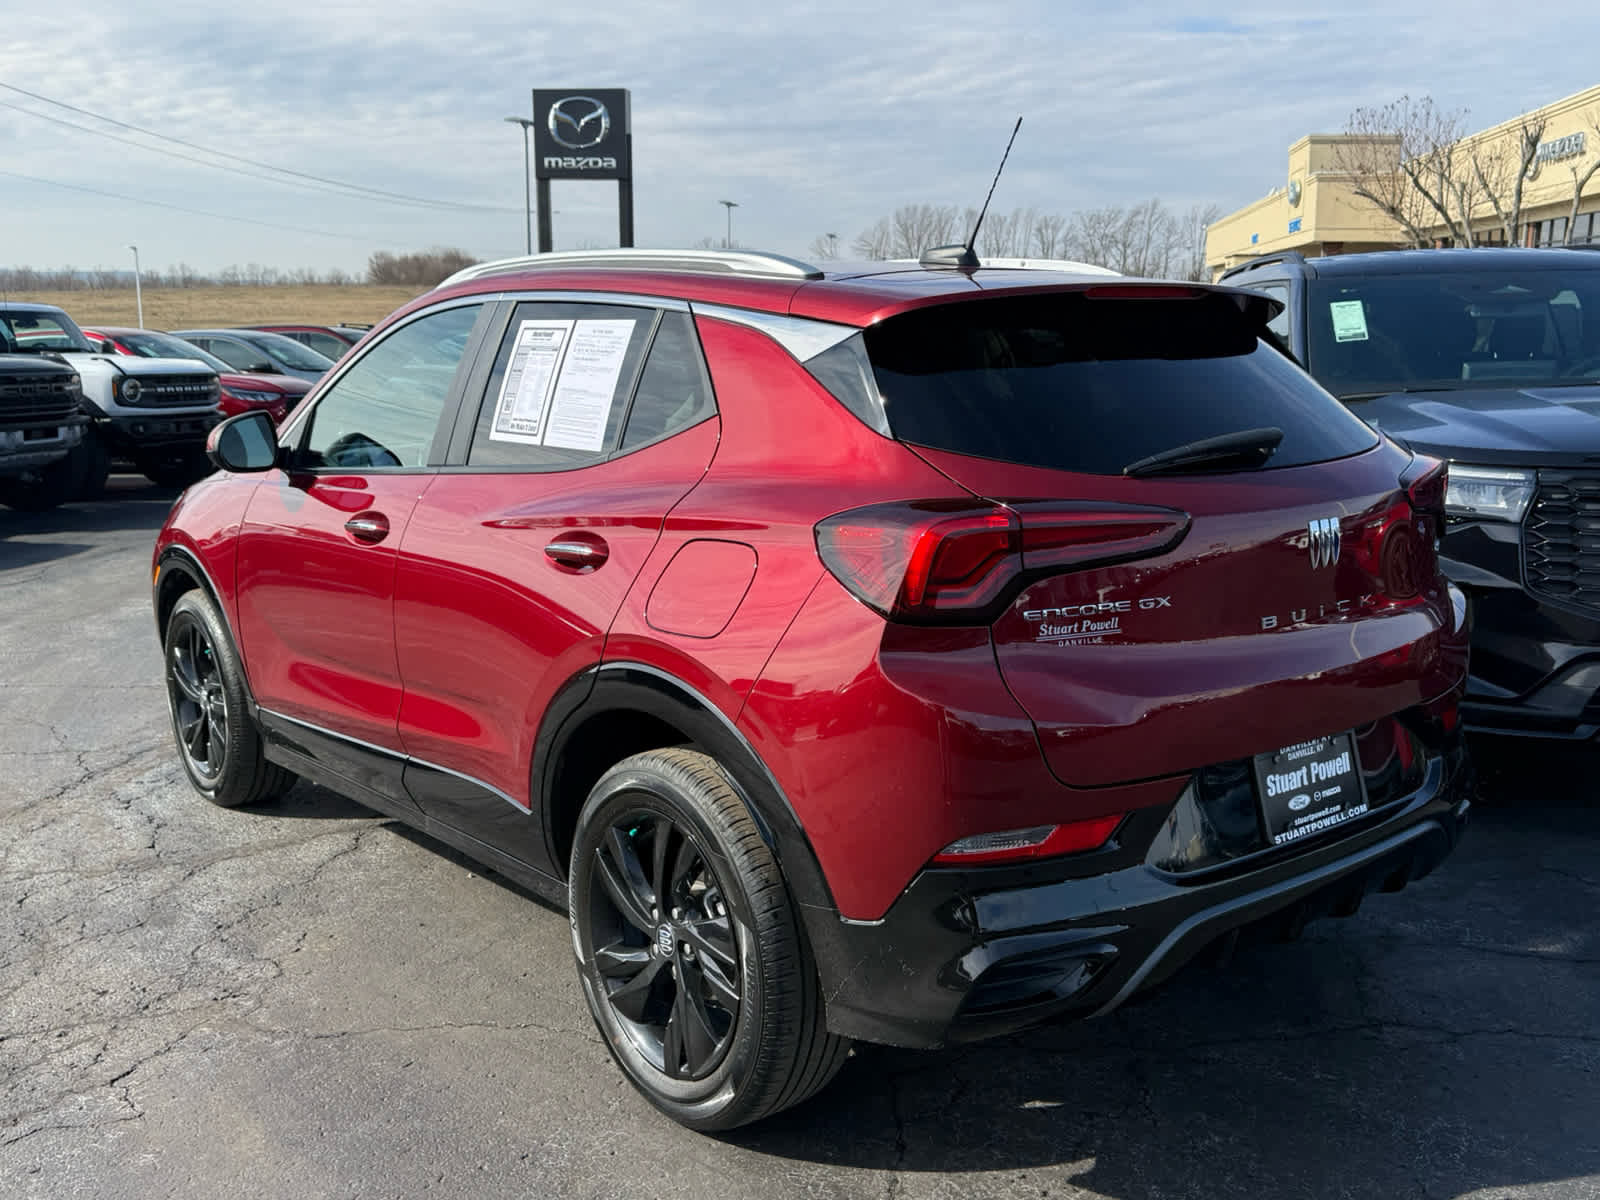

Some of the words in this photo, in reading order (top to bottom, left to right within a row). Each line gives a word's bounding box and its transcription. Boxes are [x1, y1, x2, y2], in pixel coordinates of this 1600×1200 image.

[543, 156, 617, 170] mazda
[1022, 600, 1132, 622] ENCORE
[1138, 595, 1173, 610] GX
[1260, 593, 1376, 630] BUICK
[1038, 621, 1079, 637] Stuart
[1080, 616, 1120, 633] Powell
[1058, 636, 1104, 648] DANVILLE
[1266, 765, 1309, 797] Stuart
[1310, 751, 1351, 784] Powell
[1273, 803, 1369, 845] STUARTPOWELL.COM
